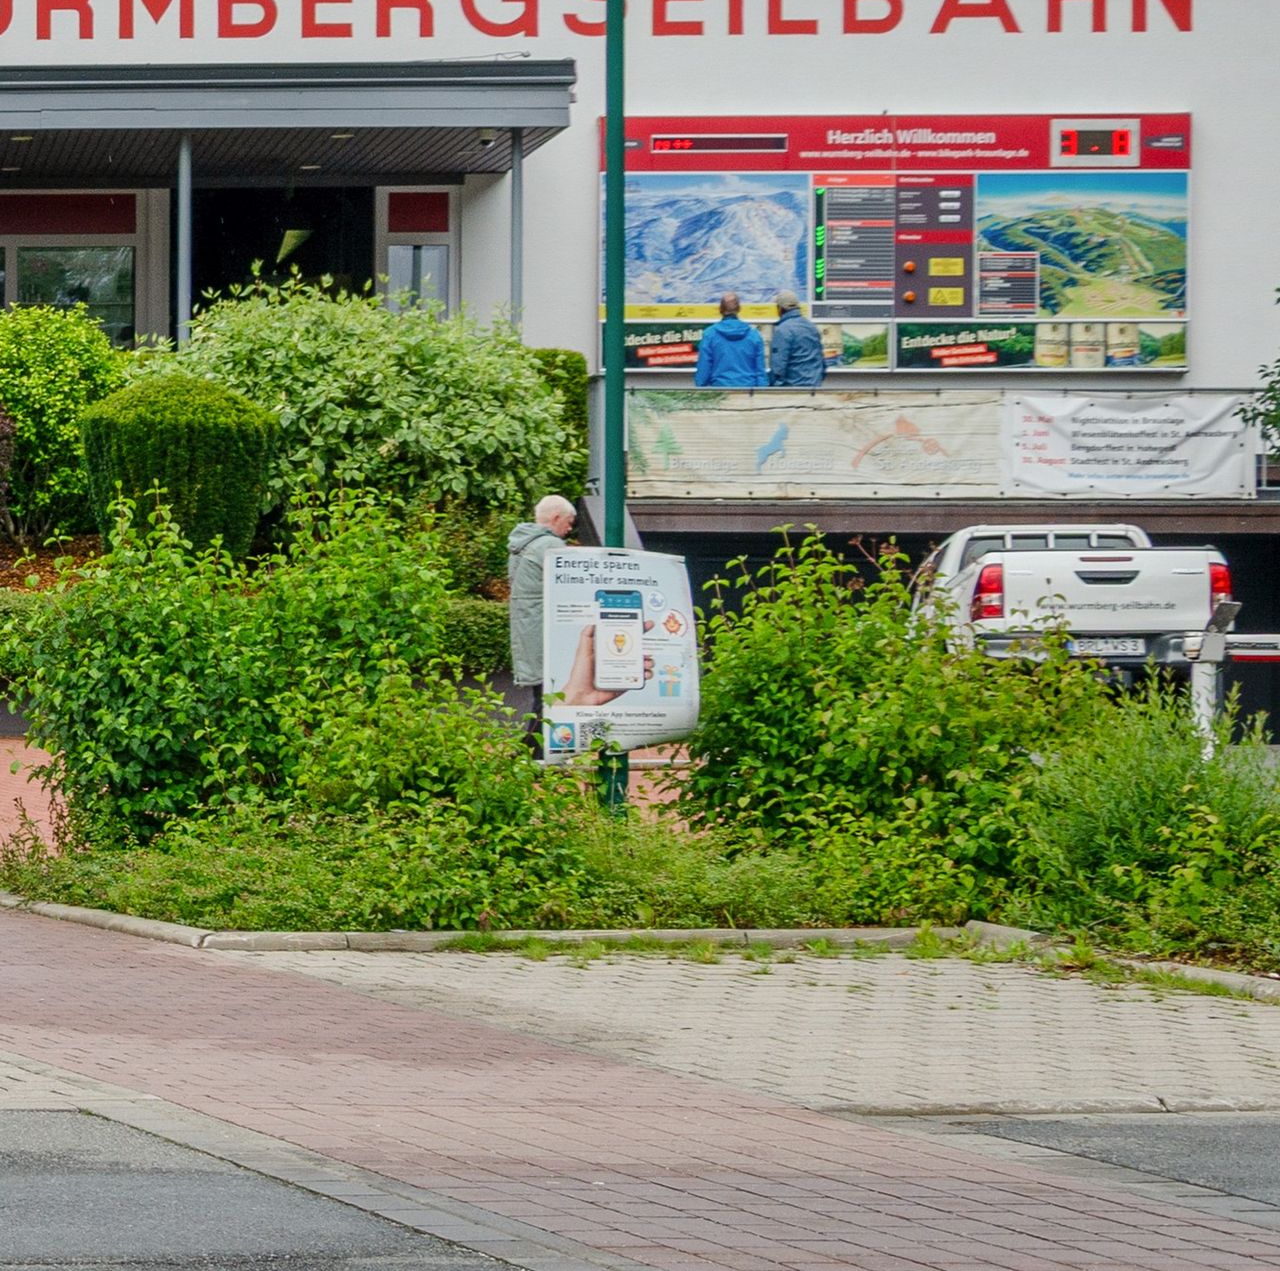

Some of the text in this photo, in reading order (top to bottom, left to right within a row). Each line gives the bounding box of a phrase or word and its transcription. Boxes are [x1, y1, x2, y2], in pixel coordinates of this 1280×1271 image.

[826, 128, 996, 145] Herzlich Willkommen
[901, 334, 955, 349] Entdecke
[957, 331, 976, 344] die
[555, 556, 640, 572] Energie sparen
[555, 573, 659, 587] Klima-Taler sammeln
[1078, 639, 1104, 652] BRL
